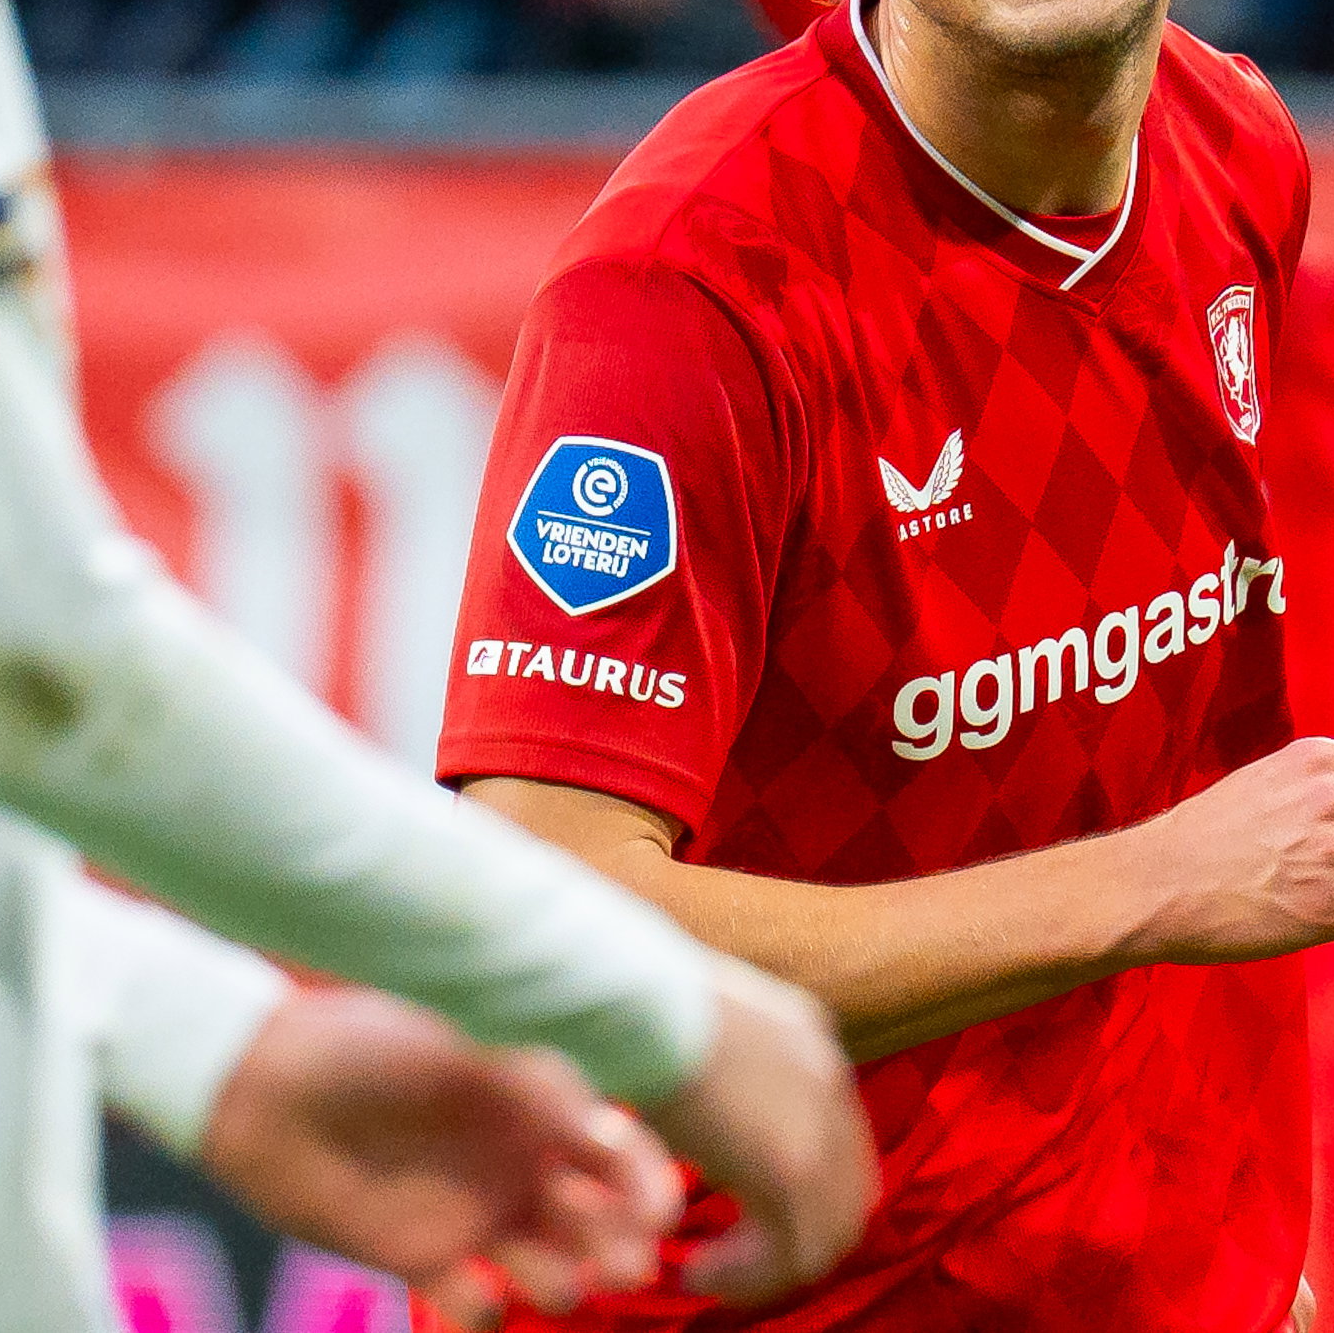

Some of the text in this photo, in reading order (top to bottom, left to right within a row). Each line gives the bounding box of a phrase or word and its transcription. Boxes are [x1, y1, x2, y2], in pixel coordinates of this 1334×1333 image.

[536, 518, 649, 560] VRIENDEN
[897, 502, 973, 543] ASTORE
[542, 541, 630, 578] LOTERIJ
[506, 640, 687, 709] TAURUS
